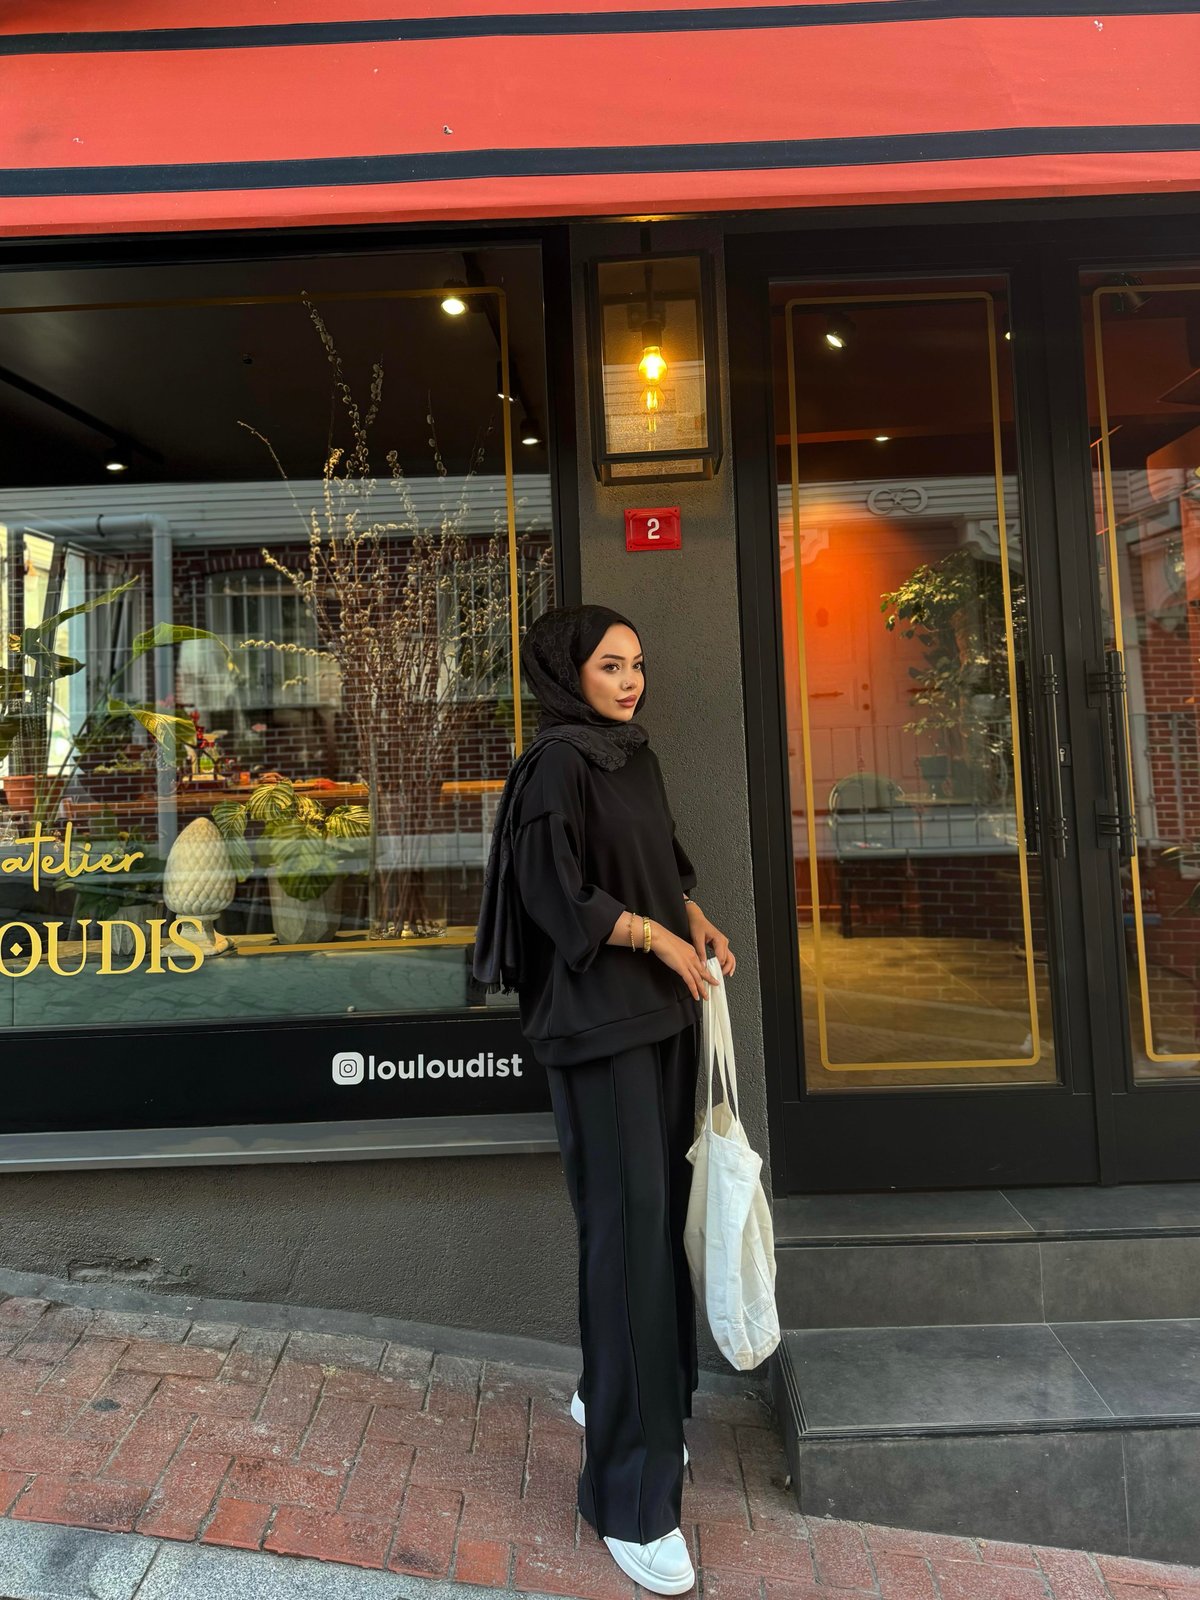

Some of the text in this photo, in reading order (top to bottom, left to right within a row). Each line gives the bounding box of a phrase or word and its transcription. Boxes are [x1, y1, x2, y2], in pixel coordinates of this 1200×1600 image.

[647, 517, 660, 540] 2
[1, 821, 144, 892] atelier
[0, 917, 205, 977] OUDIS
[368, 1052, 523, 1080] louloudist
